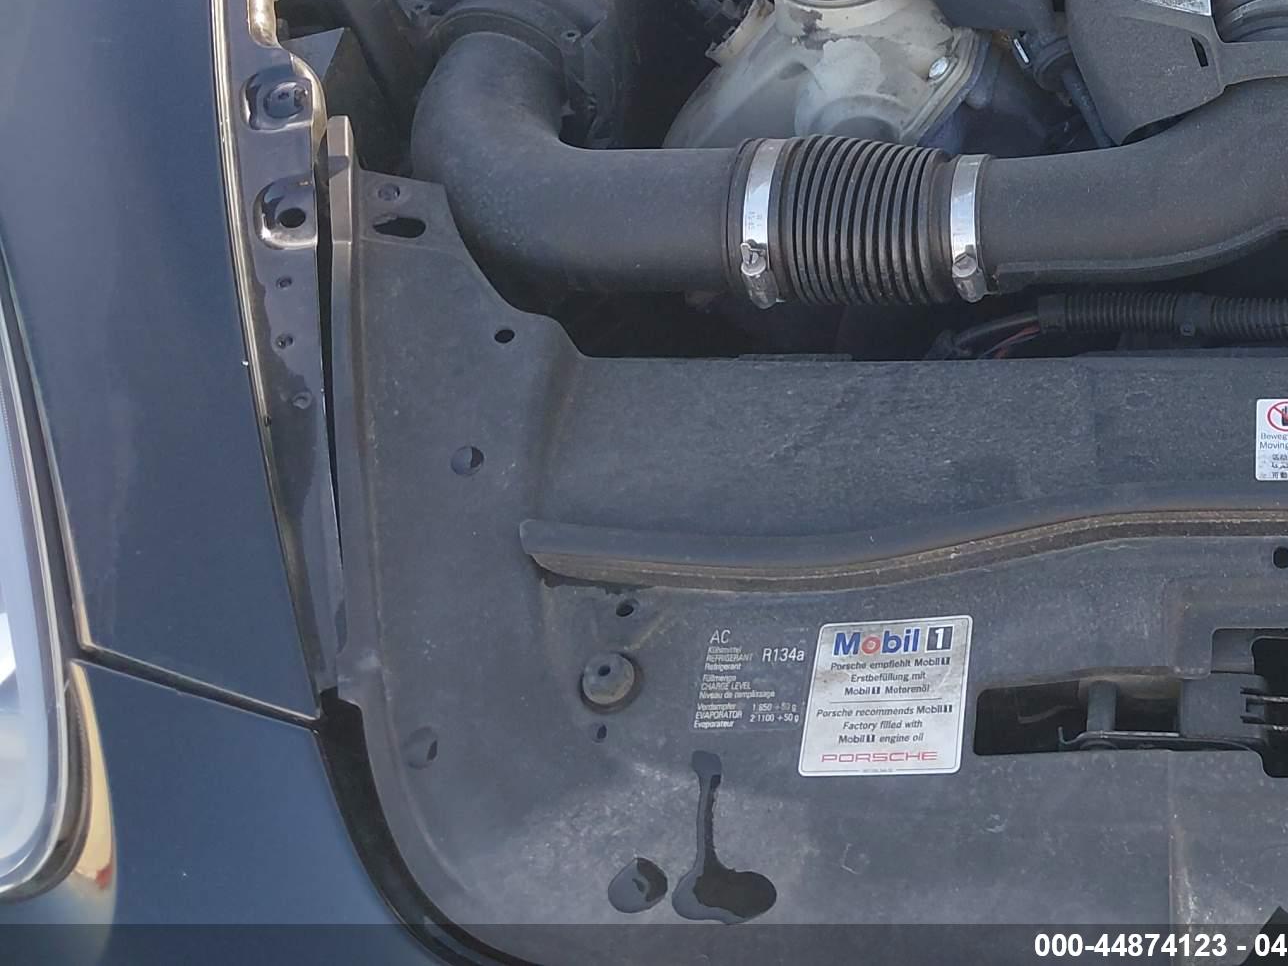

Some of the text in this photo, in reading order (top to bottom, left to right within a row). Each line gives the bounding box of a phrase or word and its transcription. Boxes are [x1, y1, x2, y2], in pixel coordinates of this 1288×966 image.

[710, 629, 731, 644] AC
[833, 628, 920, 655] Mobil
[762, 647, 805, 662] R134a
[830, 662, 866, 671] Porsche
[870, 659, 911, 670] empfiehlt
[850, 672, 926, 682] Erstbefüllung mit
[700, 682, 752, 690] CHARGE LEVEL
[884, 684, 930, 694] Motorenöl
[695, 710, 742, 720] EVAPORATOR
[816, 708, 853, 717] Porsche
[856, 706, 914, 716] recommends
[842, 720, 923, 732] Factory filled with
[880, 734, 910, 744] engine
[912, 733, 924, 742] oil
[821, 752, 938, 762] PORSCHE
